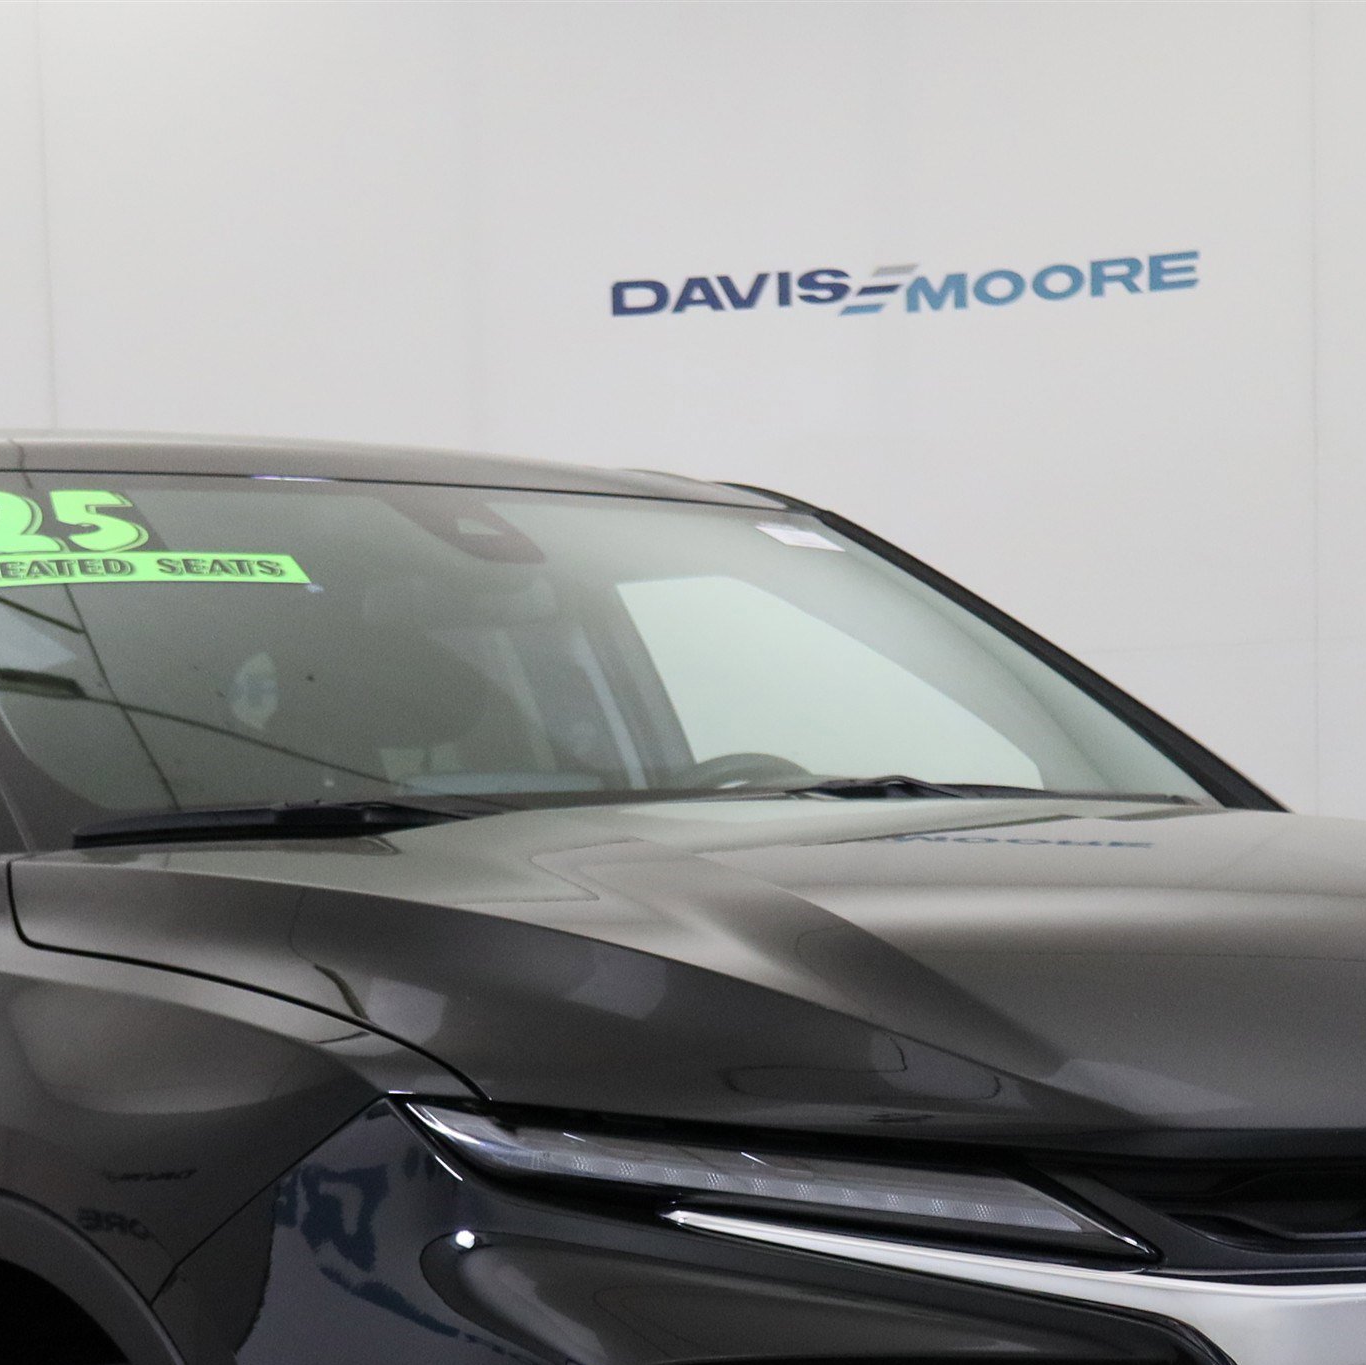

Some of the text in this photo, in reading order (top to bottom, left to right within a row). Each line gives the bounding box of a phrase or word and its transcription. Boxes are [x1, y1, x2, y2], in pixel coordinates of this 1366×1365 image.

[610, 250, 1200, 318] DAVIS MOORE
[156, 556, 286, 578] SEATS
